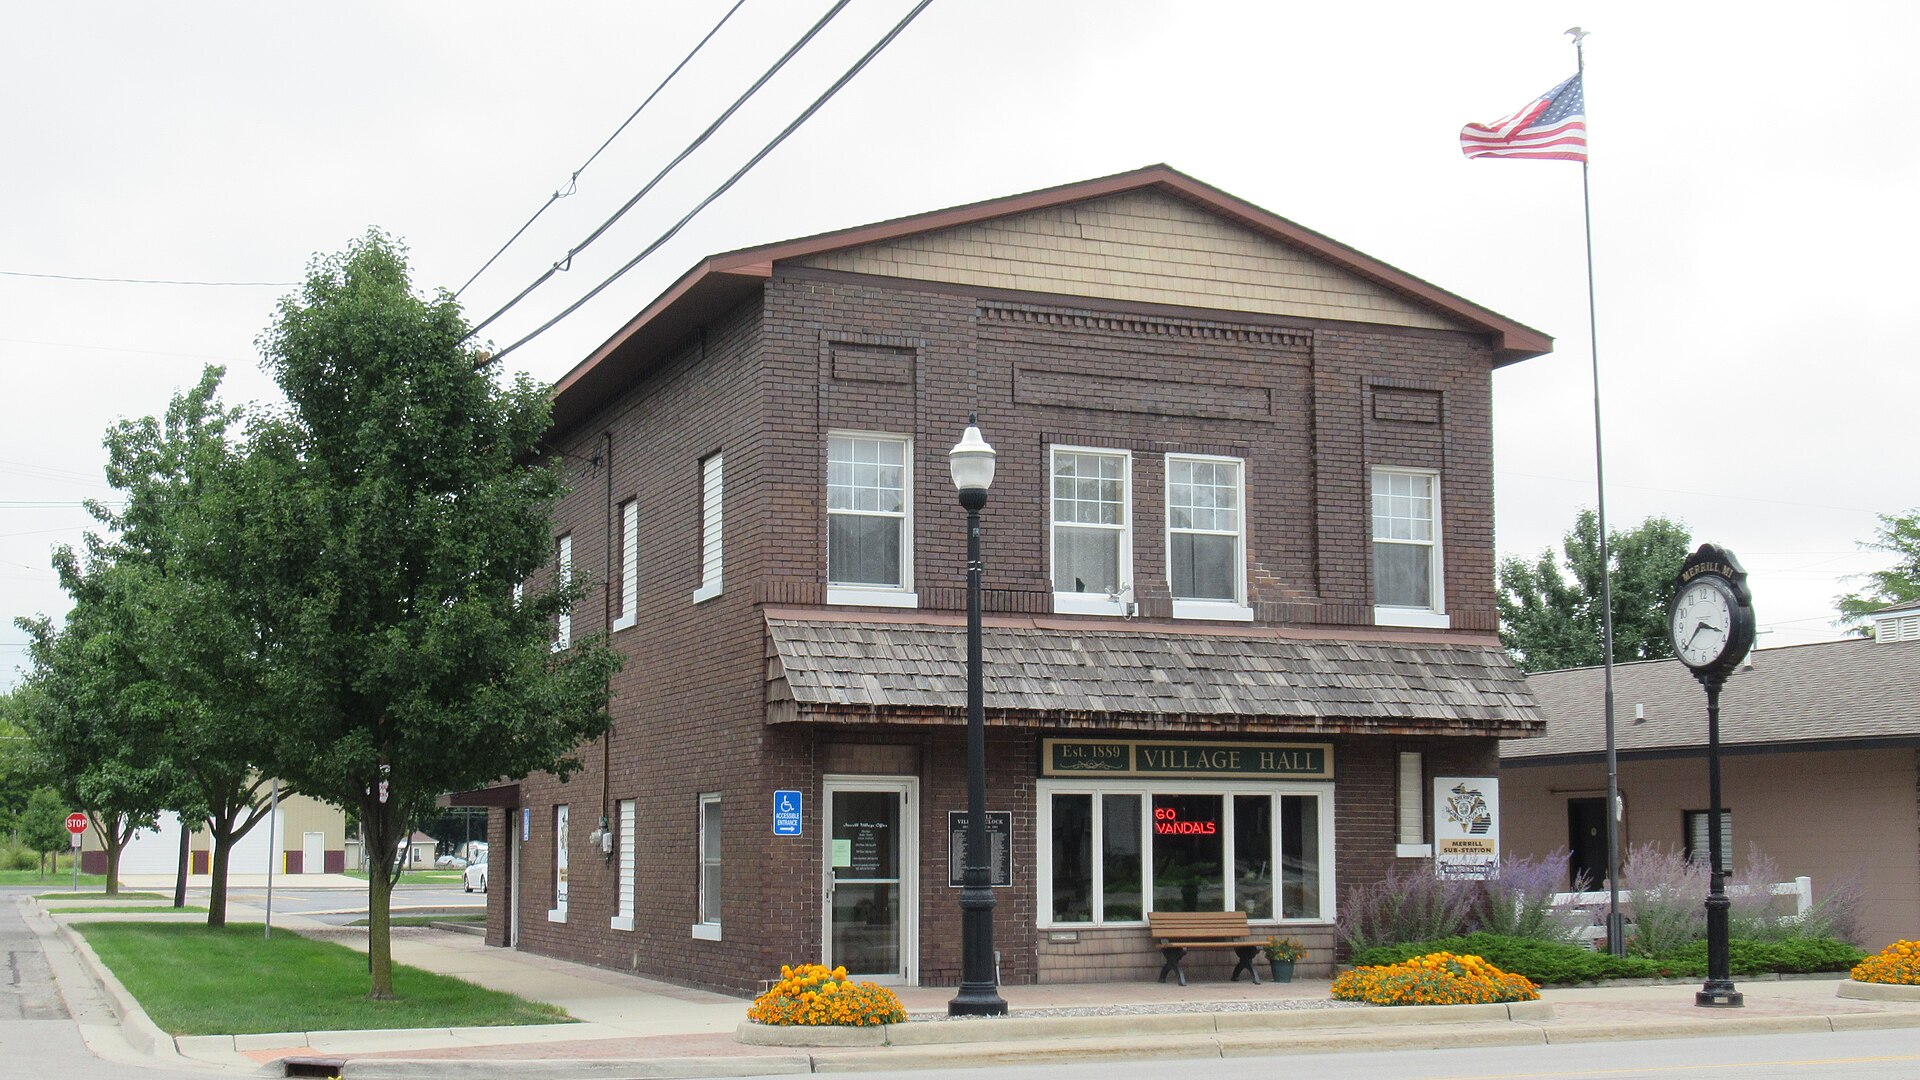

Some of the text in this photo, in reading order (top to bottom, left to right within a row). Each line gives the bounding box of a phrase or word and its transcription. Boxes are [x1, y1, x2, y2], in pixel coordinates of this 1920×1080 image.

[1721, 564, 1734, 579] MI
[1688, 594, 1694, 606] 11
[1699, 589, 1707, 599] 12
[1679, 608, 1687, 619] 10
[1678, 623, 1684, 633] 9
[1063, 745, 1120, 758] Est. 1889
[1144, 750, 1317, 770] VILLAGE HALL
[1155, 808, 1176, 820] GO
[67, 819, 87, 828] STOP
[1156, 822, 1216, 834] VANDALS
